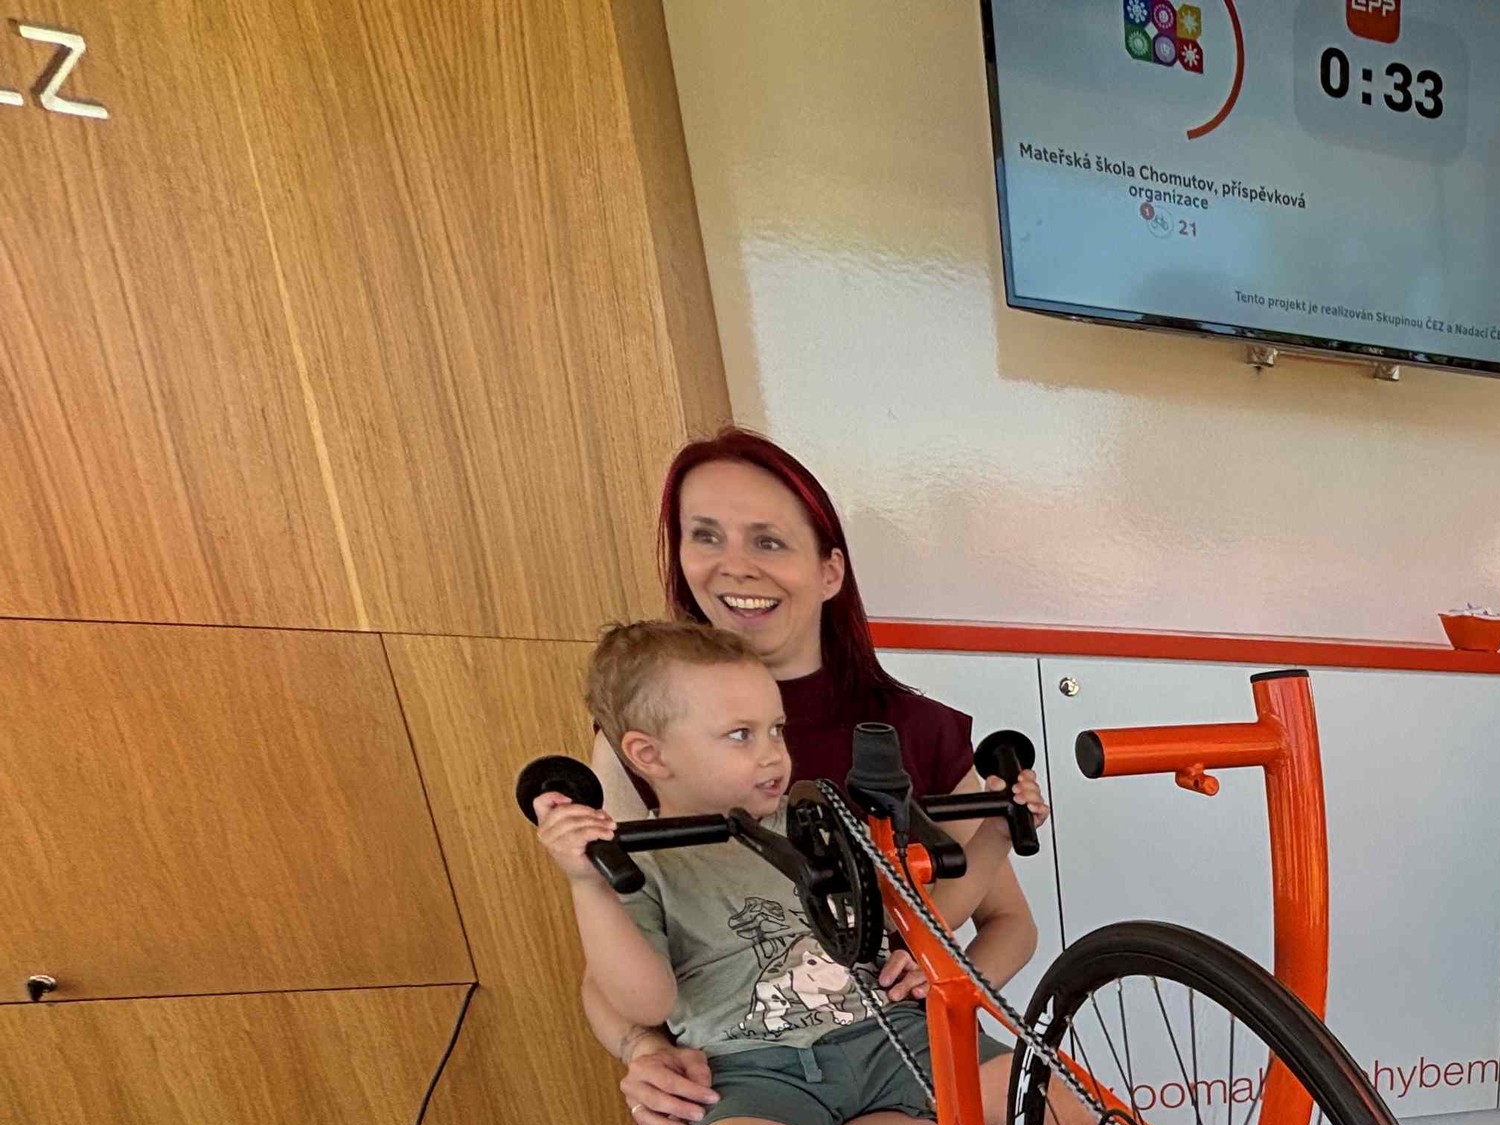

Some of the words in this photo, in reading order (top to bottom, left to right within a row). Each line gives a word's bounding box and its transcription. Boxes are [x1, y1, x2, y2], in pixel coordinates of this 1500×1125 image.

[0, 25, 109, 119] Z
[1320, 47, 1444, 119] 0:33
[1019, 142, 1092, 170] Mateřská
[1095, 155, 1135, 178] škola
[1139, 165, 1218, 196] Chomutov,
[1222, 180, 1306, 209] příspěvková
[1128, 184, 1209, 210] organizace
[1178, 219, 1197, 237] 21
[1235, 290, 1265, 306] Tento
[1268, 296, 1306, 311] projekt
[1307, 301, 1319, 315] je
[1321, 304, 1374, 321] realizován
[1375, 312, 1423, 329] Skupinou
[1425, 316, 1445, 332] ČEZ
